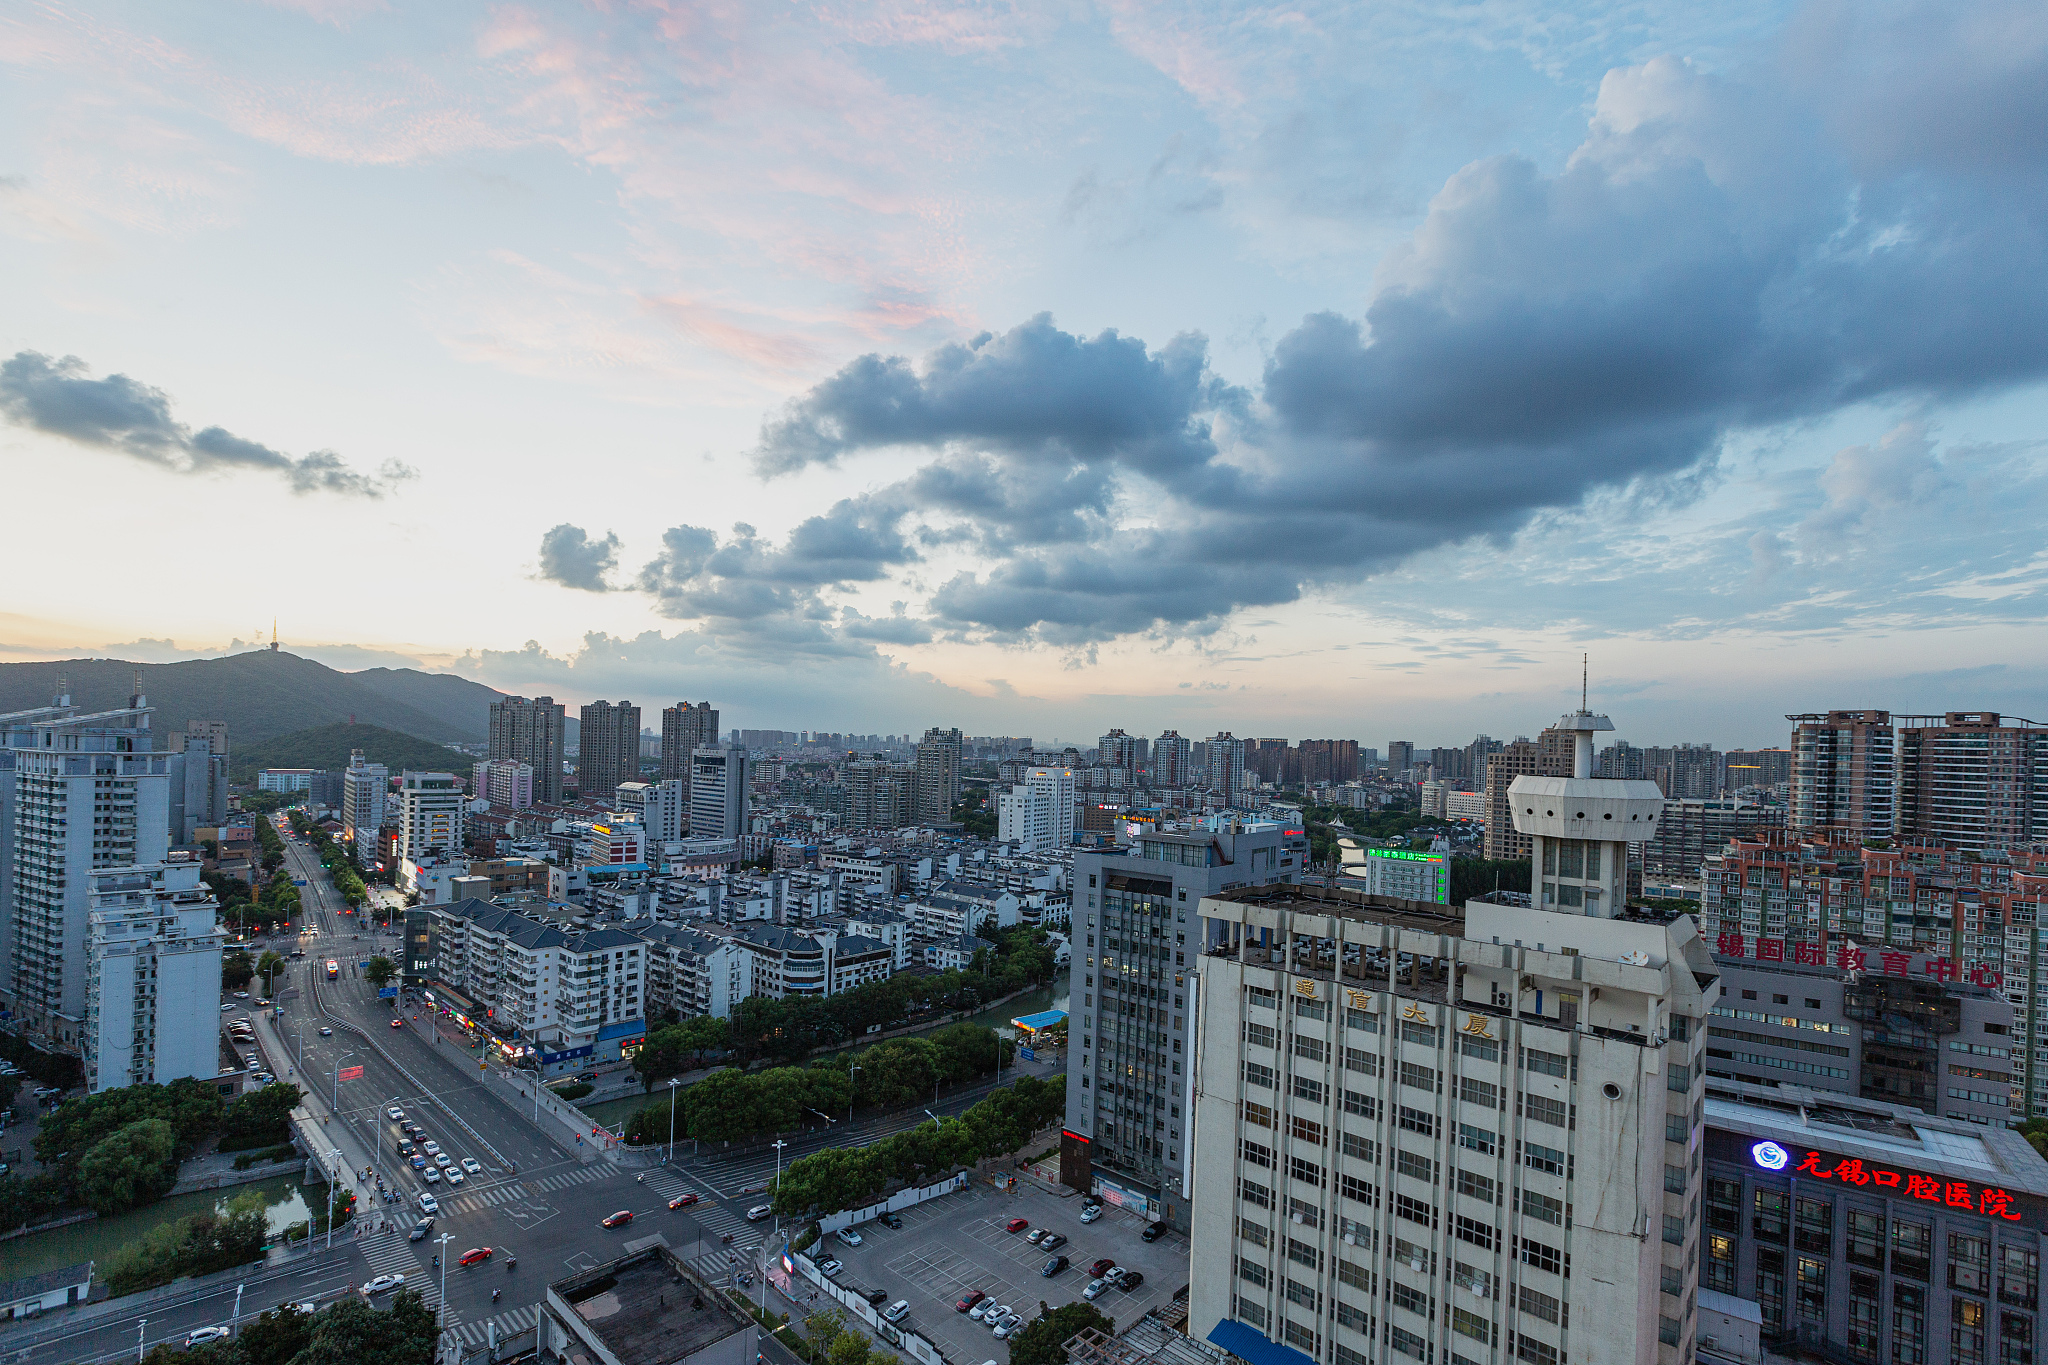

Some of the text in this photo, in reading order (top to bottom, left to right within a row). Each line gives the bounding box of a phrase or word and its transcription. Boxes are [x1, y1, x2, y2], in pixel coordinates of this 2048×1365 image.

[1296, 979, 1493, 1038] 通信大厦
[1796, 1151, 2021, 1220] 无锡口腔医院
